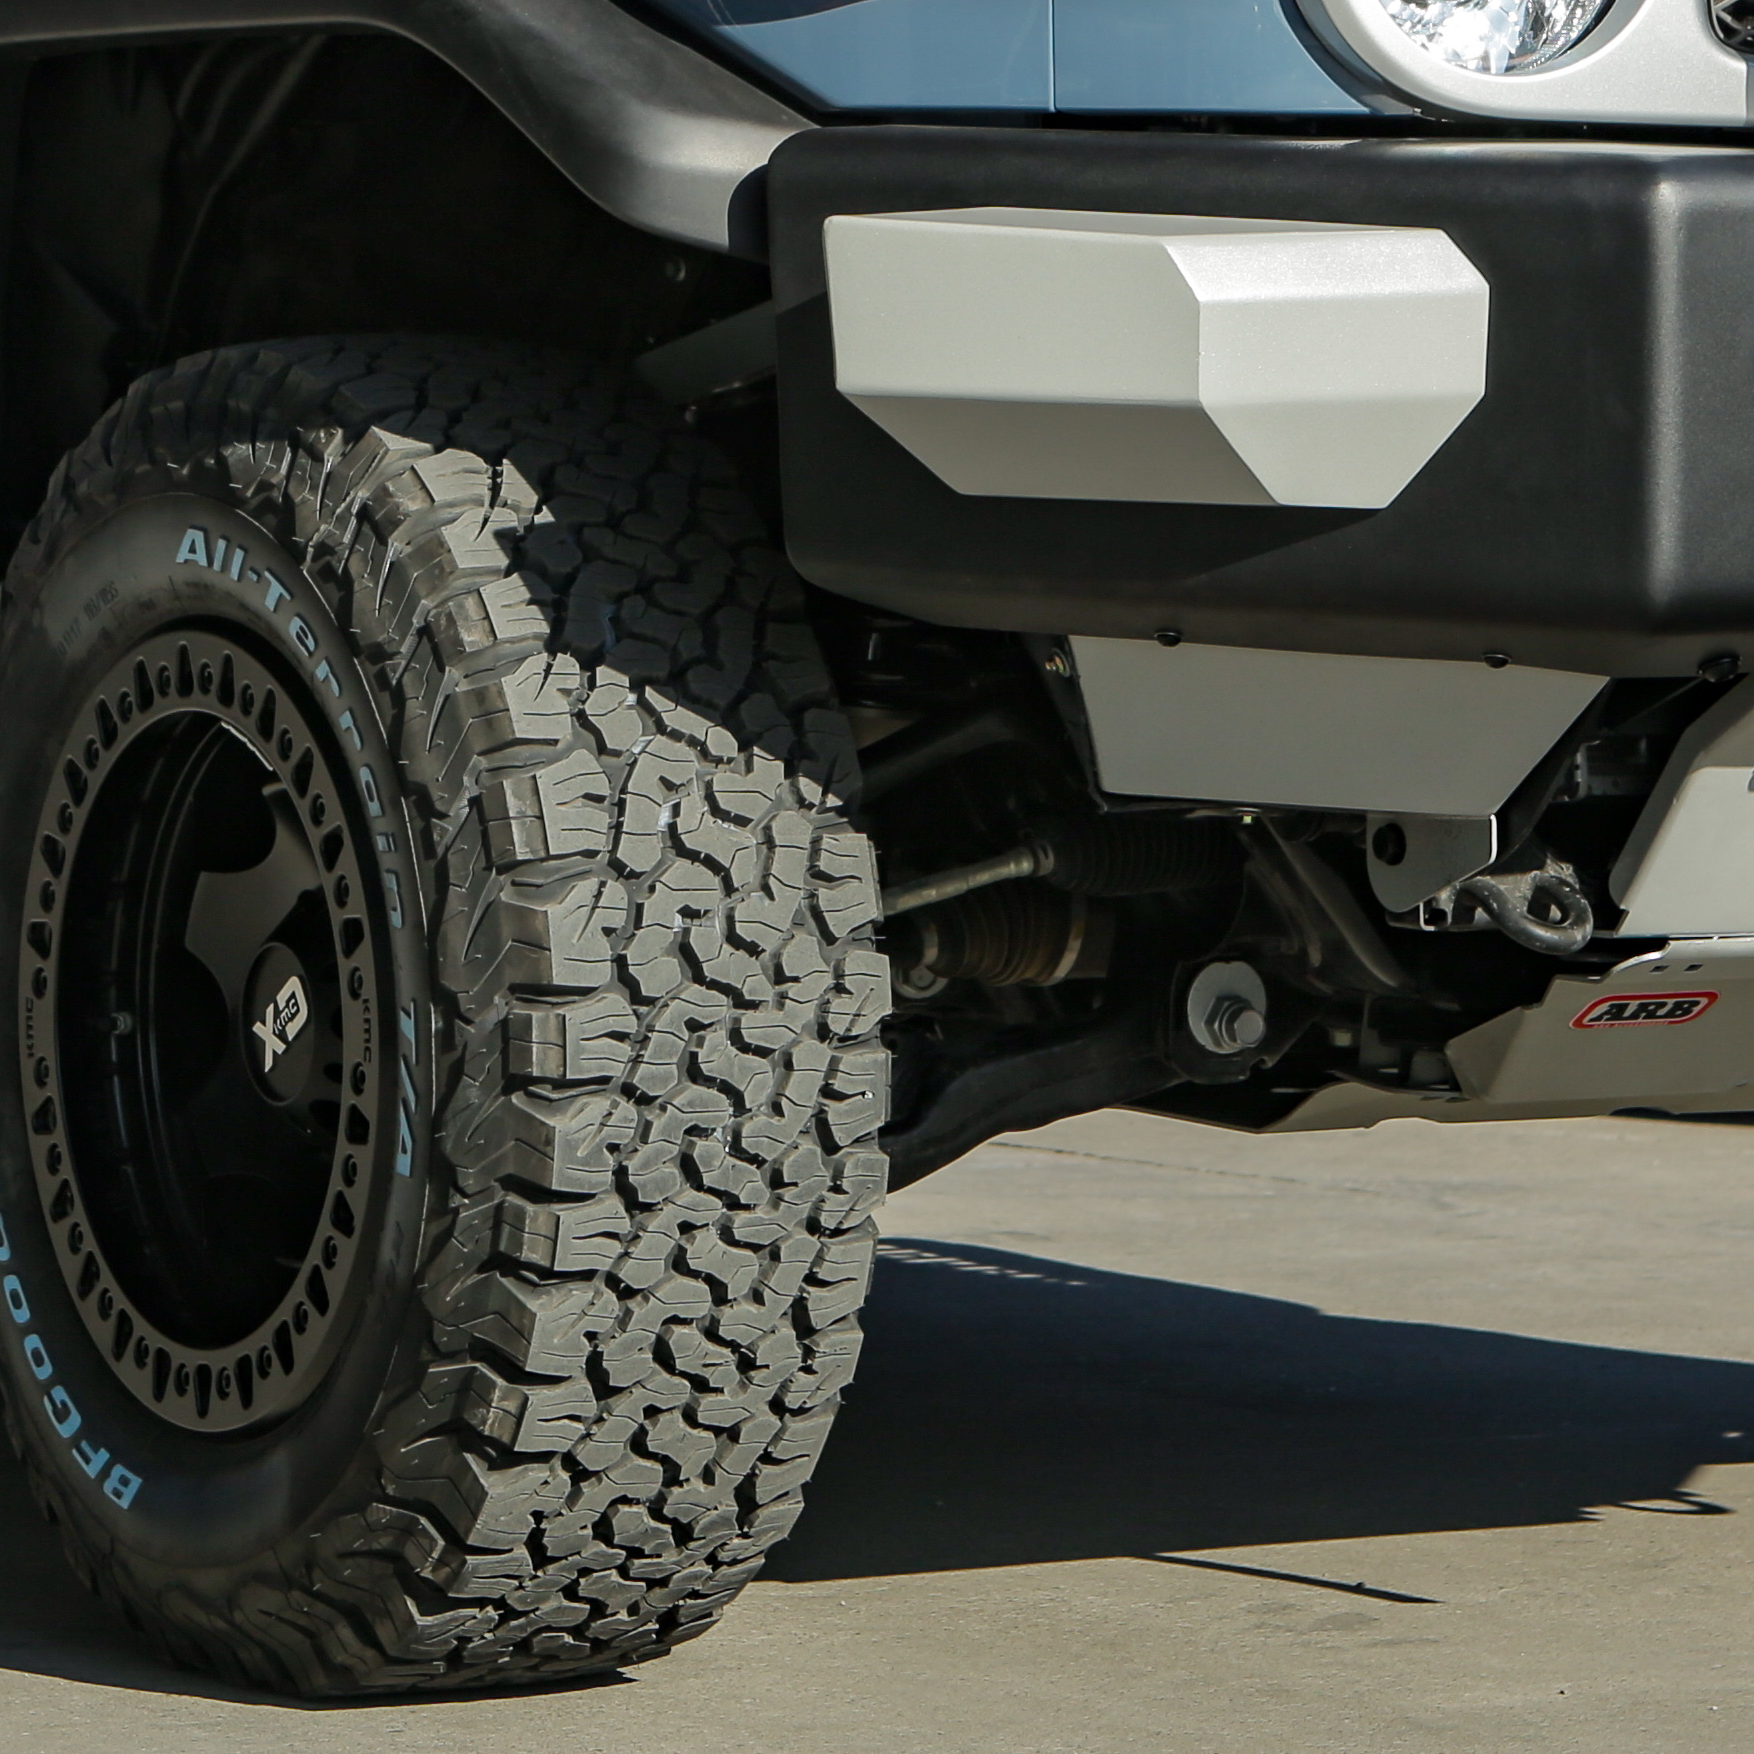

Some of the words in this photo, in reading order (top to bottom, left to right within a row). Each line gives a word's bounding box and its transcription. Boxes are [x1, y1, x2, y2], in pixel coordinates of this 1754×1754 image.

[175, 525, 405, 930] All-Terrain
[394, 998, 418, 1178] T/A
[252, 975, 309, 1074] XD
[1586, 999, 1702, 1023] ARB
